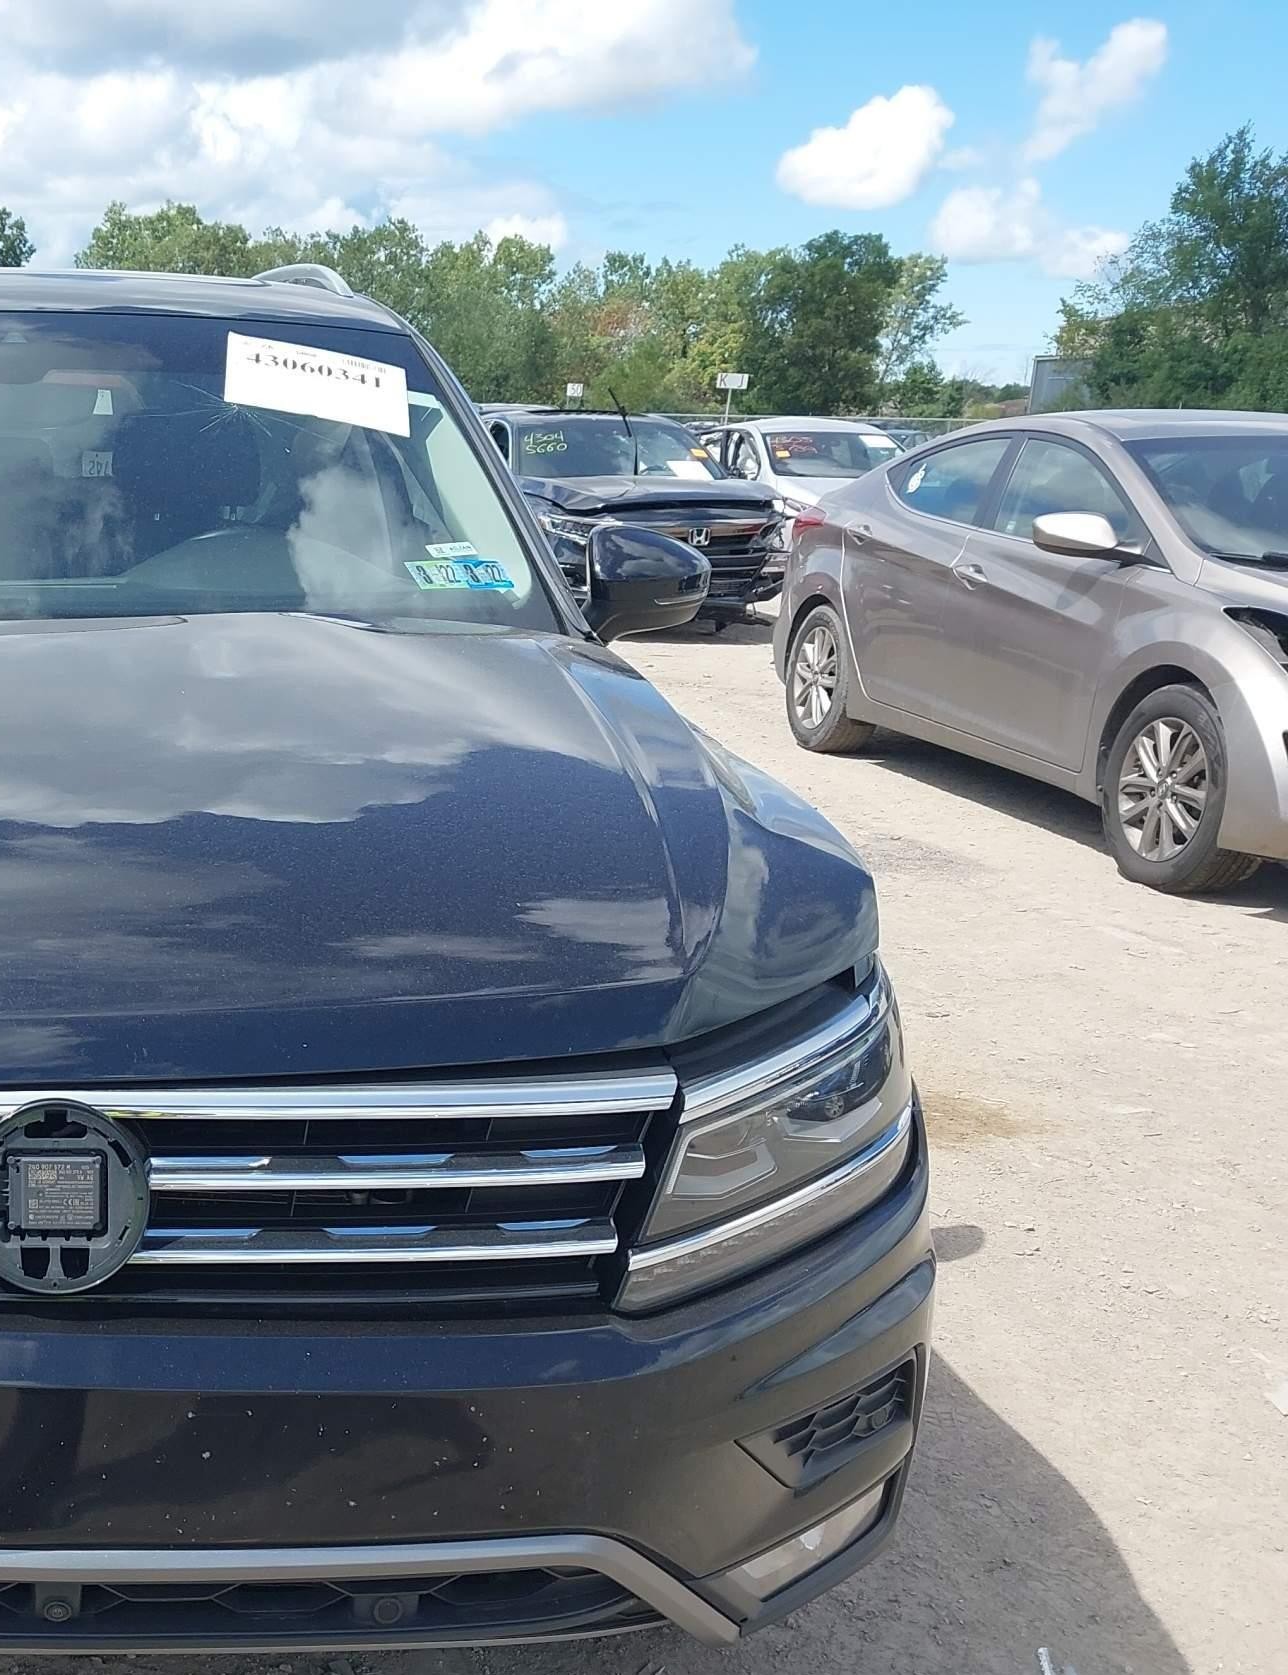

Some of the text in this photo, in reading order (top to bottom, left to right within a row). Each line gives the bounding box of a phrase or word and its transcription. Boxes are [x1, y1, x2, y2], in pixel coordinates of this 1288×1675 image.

[246, 353, 380, 388] 43060341
[719, 374, 745, 388] K J
[523, 430, 565, 445] 4304
[526, 442, 568, 455] 5660
